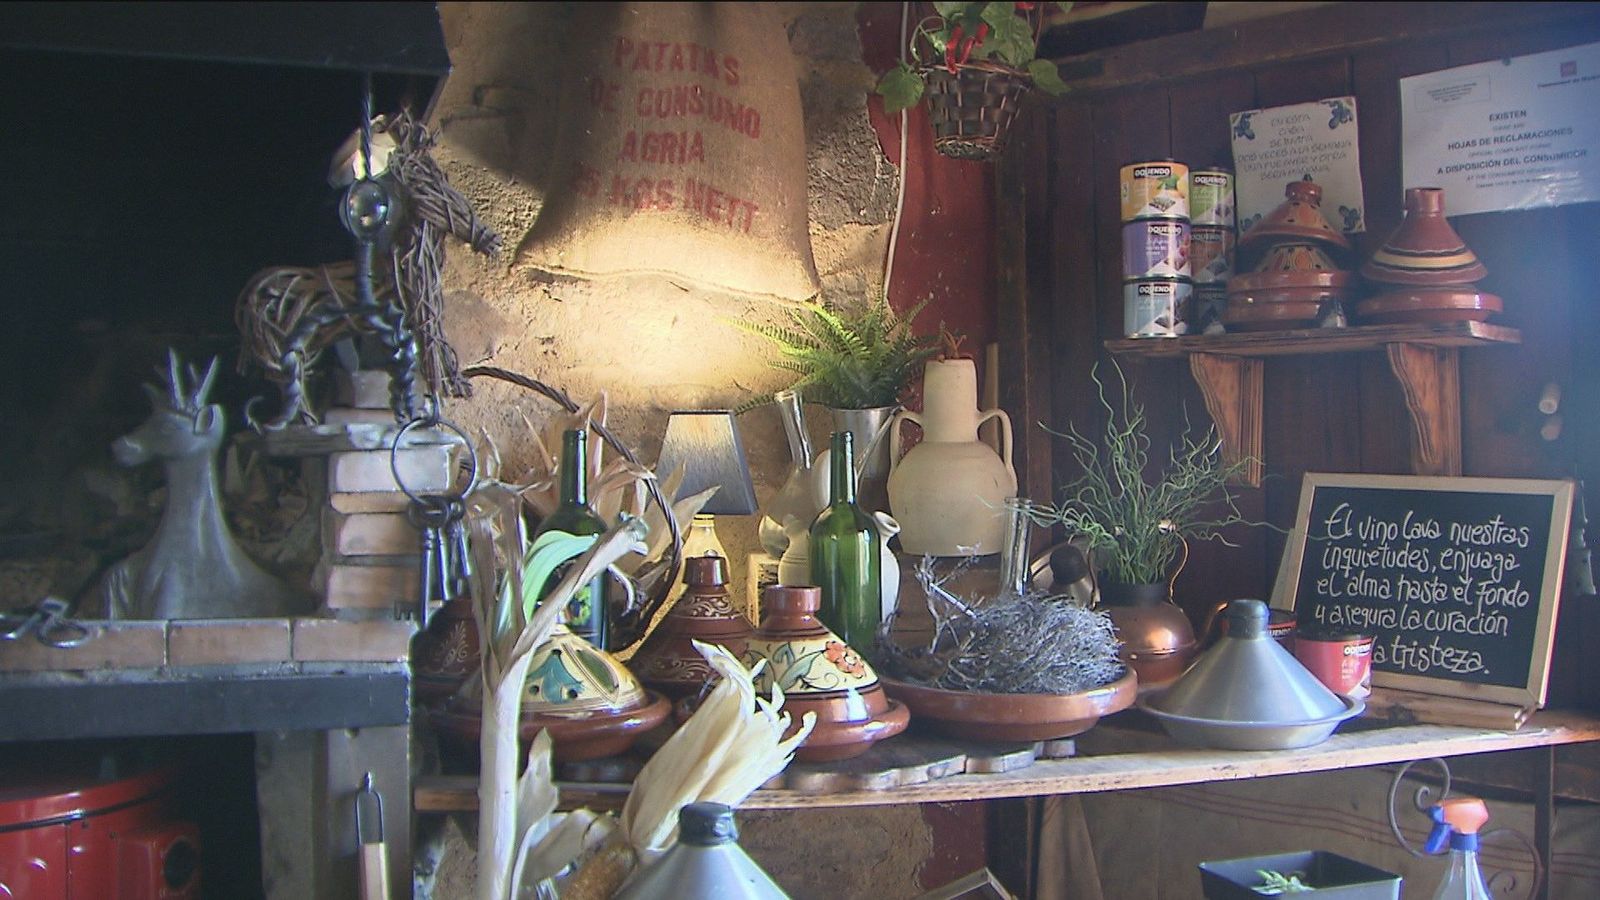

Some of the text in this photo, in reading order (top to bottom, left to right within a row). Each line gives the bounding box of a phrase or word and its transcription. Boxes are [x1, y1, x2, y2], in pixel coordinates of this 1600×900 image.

[614, 36, 739, 86] PATATAS
[637, 84, 760, 139] CONSUMO
[1489, 109, 1526, 122] EXISTEN
[617, 130, 705, 165] AGRIA
[1448, 127, 1573, 151] HOJAS DE RECLAMACIONES
[1134, 167, 1170, 178] OQUENDO
[1438, 150, 1587, 175] A DISPOSICIÓN DEL CONSUMIDOR
[1194, 176, 1227, 186] OQUENDO
[1147, 226, 1182, 236] OQUENDO
[1138, 285, 1174, 296] OQUENDO
[1324, 502, 1530, 548] El vino lava nuestras
[1322, 541, 1520, 584] inquietudes, enjuaga
[1317, 572, 1342, 597] el
[1347, 570, 1392, 600] alma
[1398, 574, 1448, 605] hasta
[1452, 577, 1473, 605] el
[1400, 603, 1420, 630] la
[1424, 610, 1508, 637] curación
[1391, 636, 1490, 674] tristeza.
